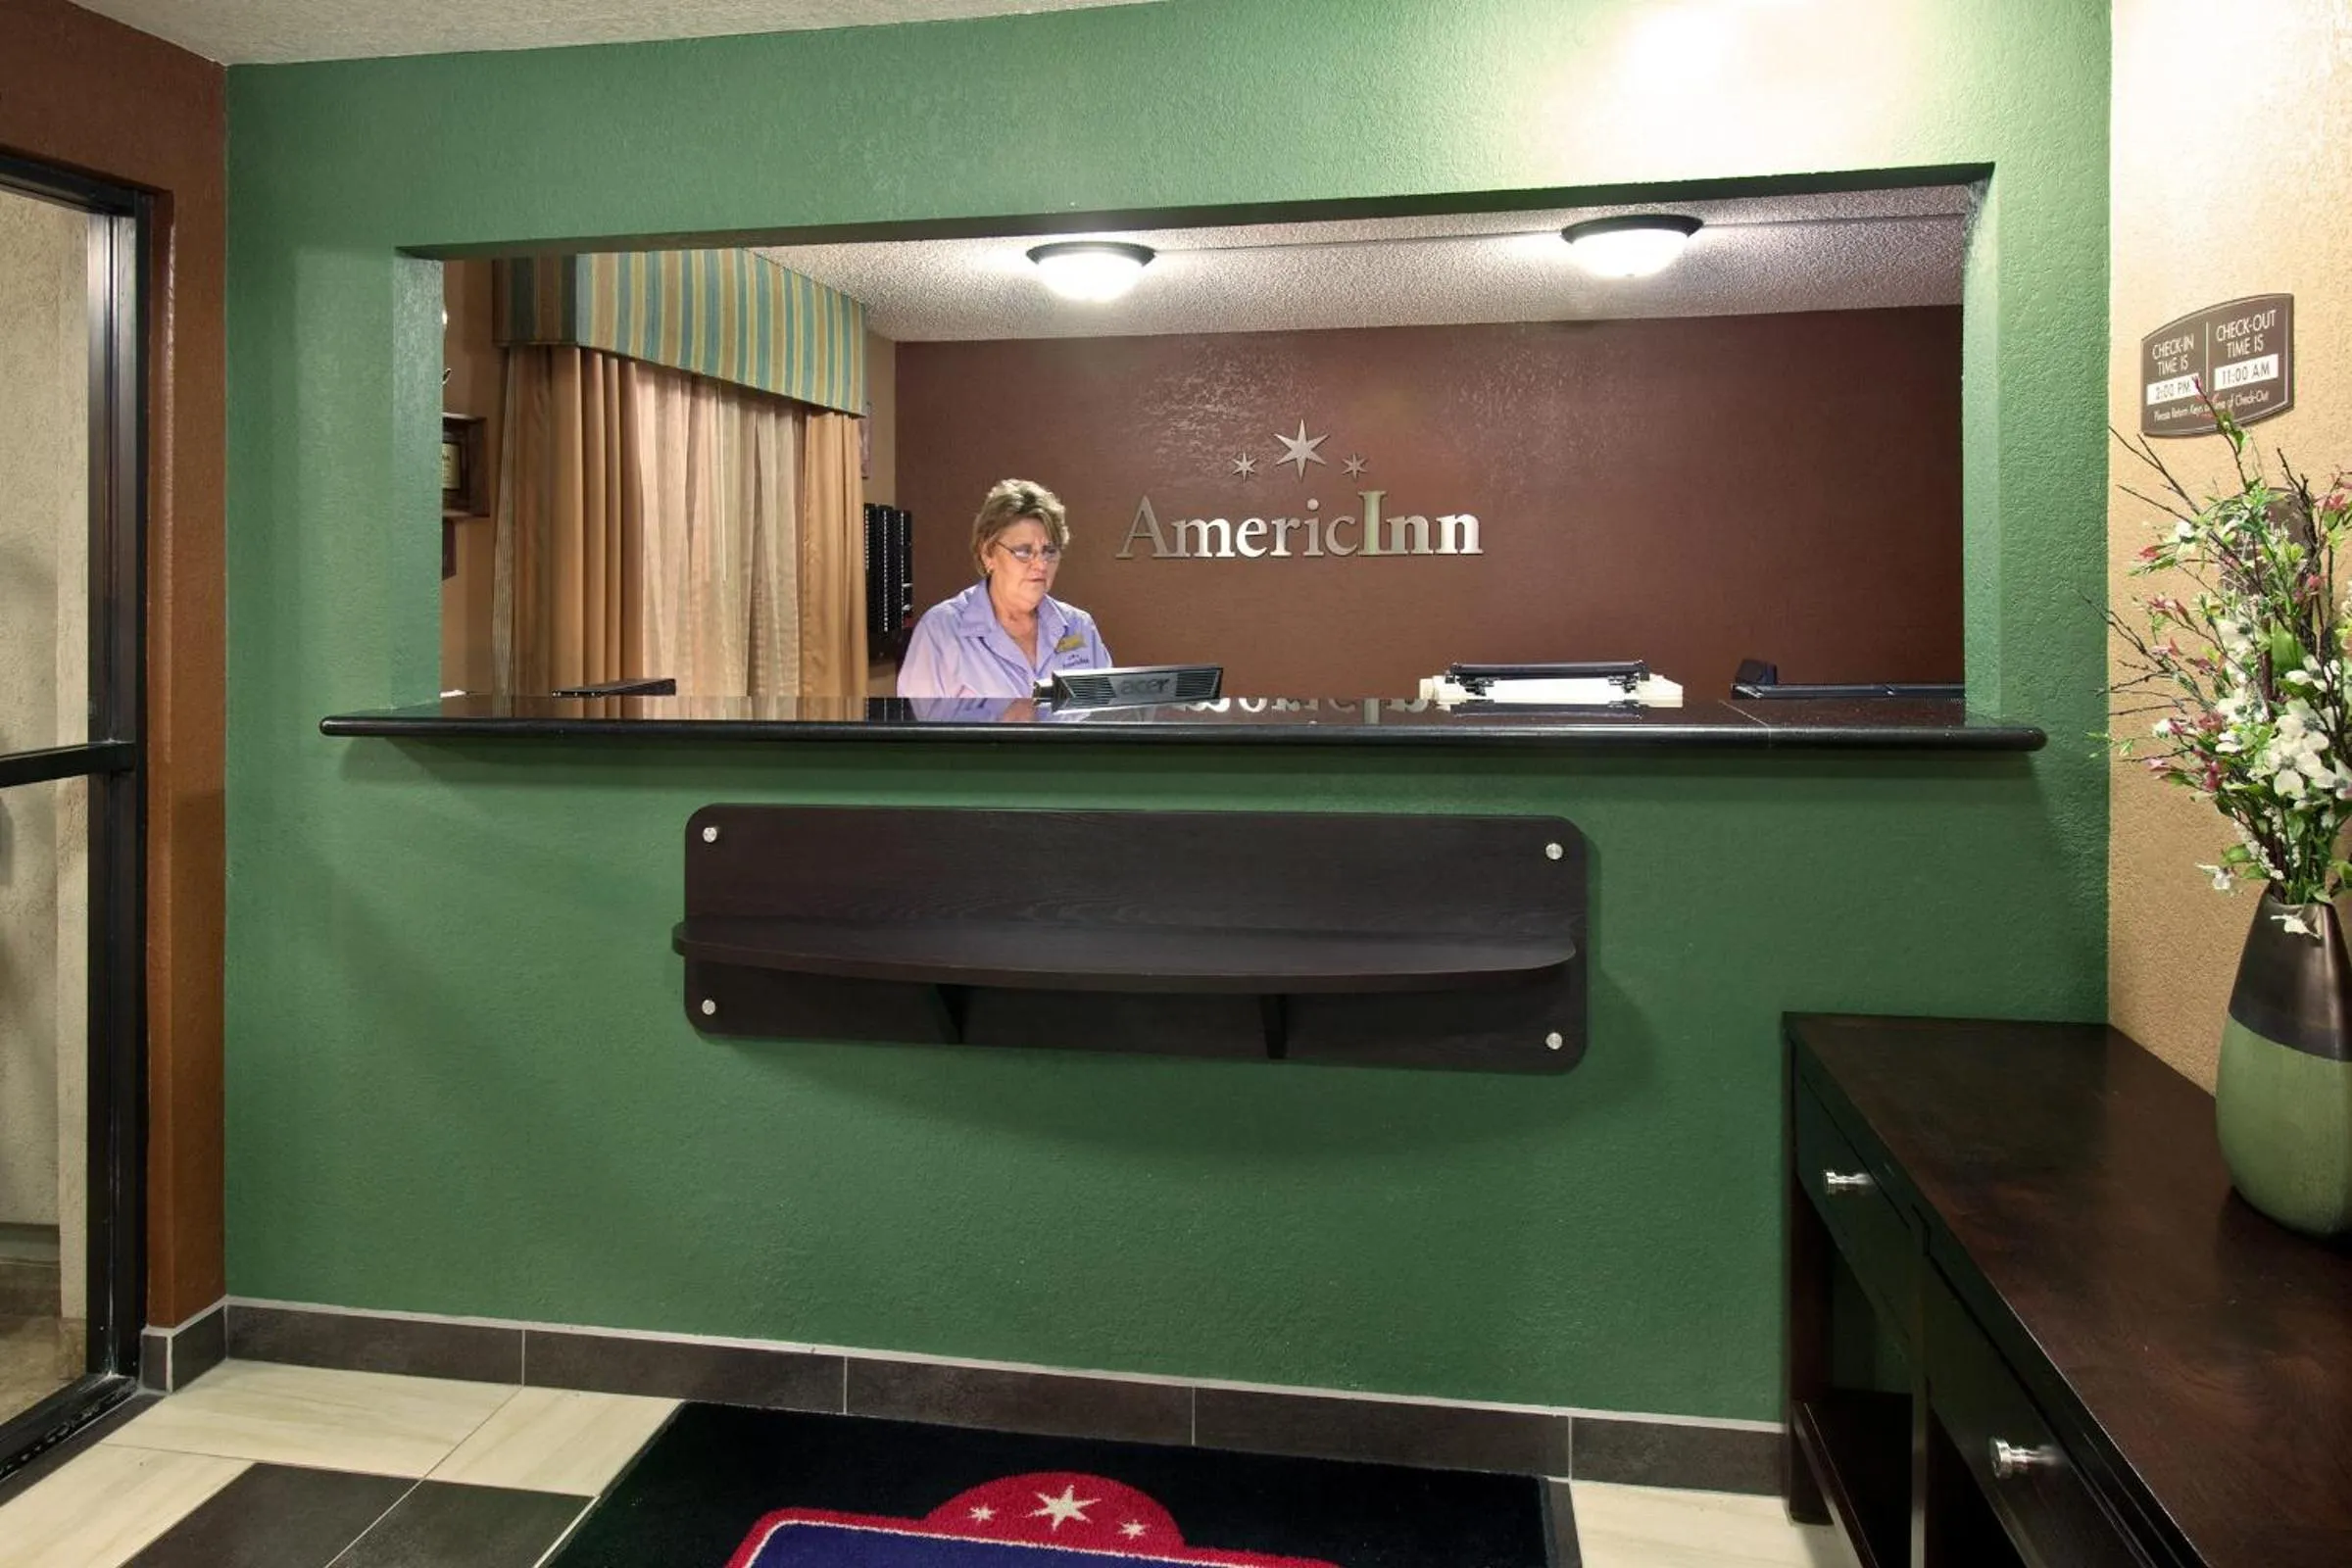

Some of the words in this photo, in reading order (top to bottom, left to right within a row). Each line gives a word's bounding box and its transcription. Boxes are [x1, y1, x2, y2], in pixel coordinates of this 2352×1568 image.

[2216, 310, 2277, 342] CHECK-OUT
[2152, 333, 2194, 360] CHECK-IN
[2227, 336, 2251, 359] TIME
[2254, 333, 2264, 353] IS
[2157, 357, 2178, 376] TIME
[2180, 354, 2188, 371] IS
[2223, 366, 2248, 385] 11:00
[2252, 361, 2270, 379] AM
[2178, 380, 2191, 395] PM
[1115, 490, 1485, 560] AmericInn
[1120, 678, 1170, 695] acer
